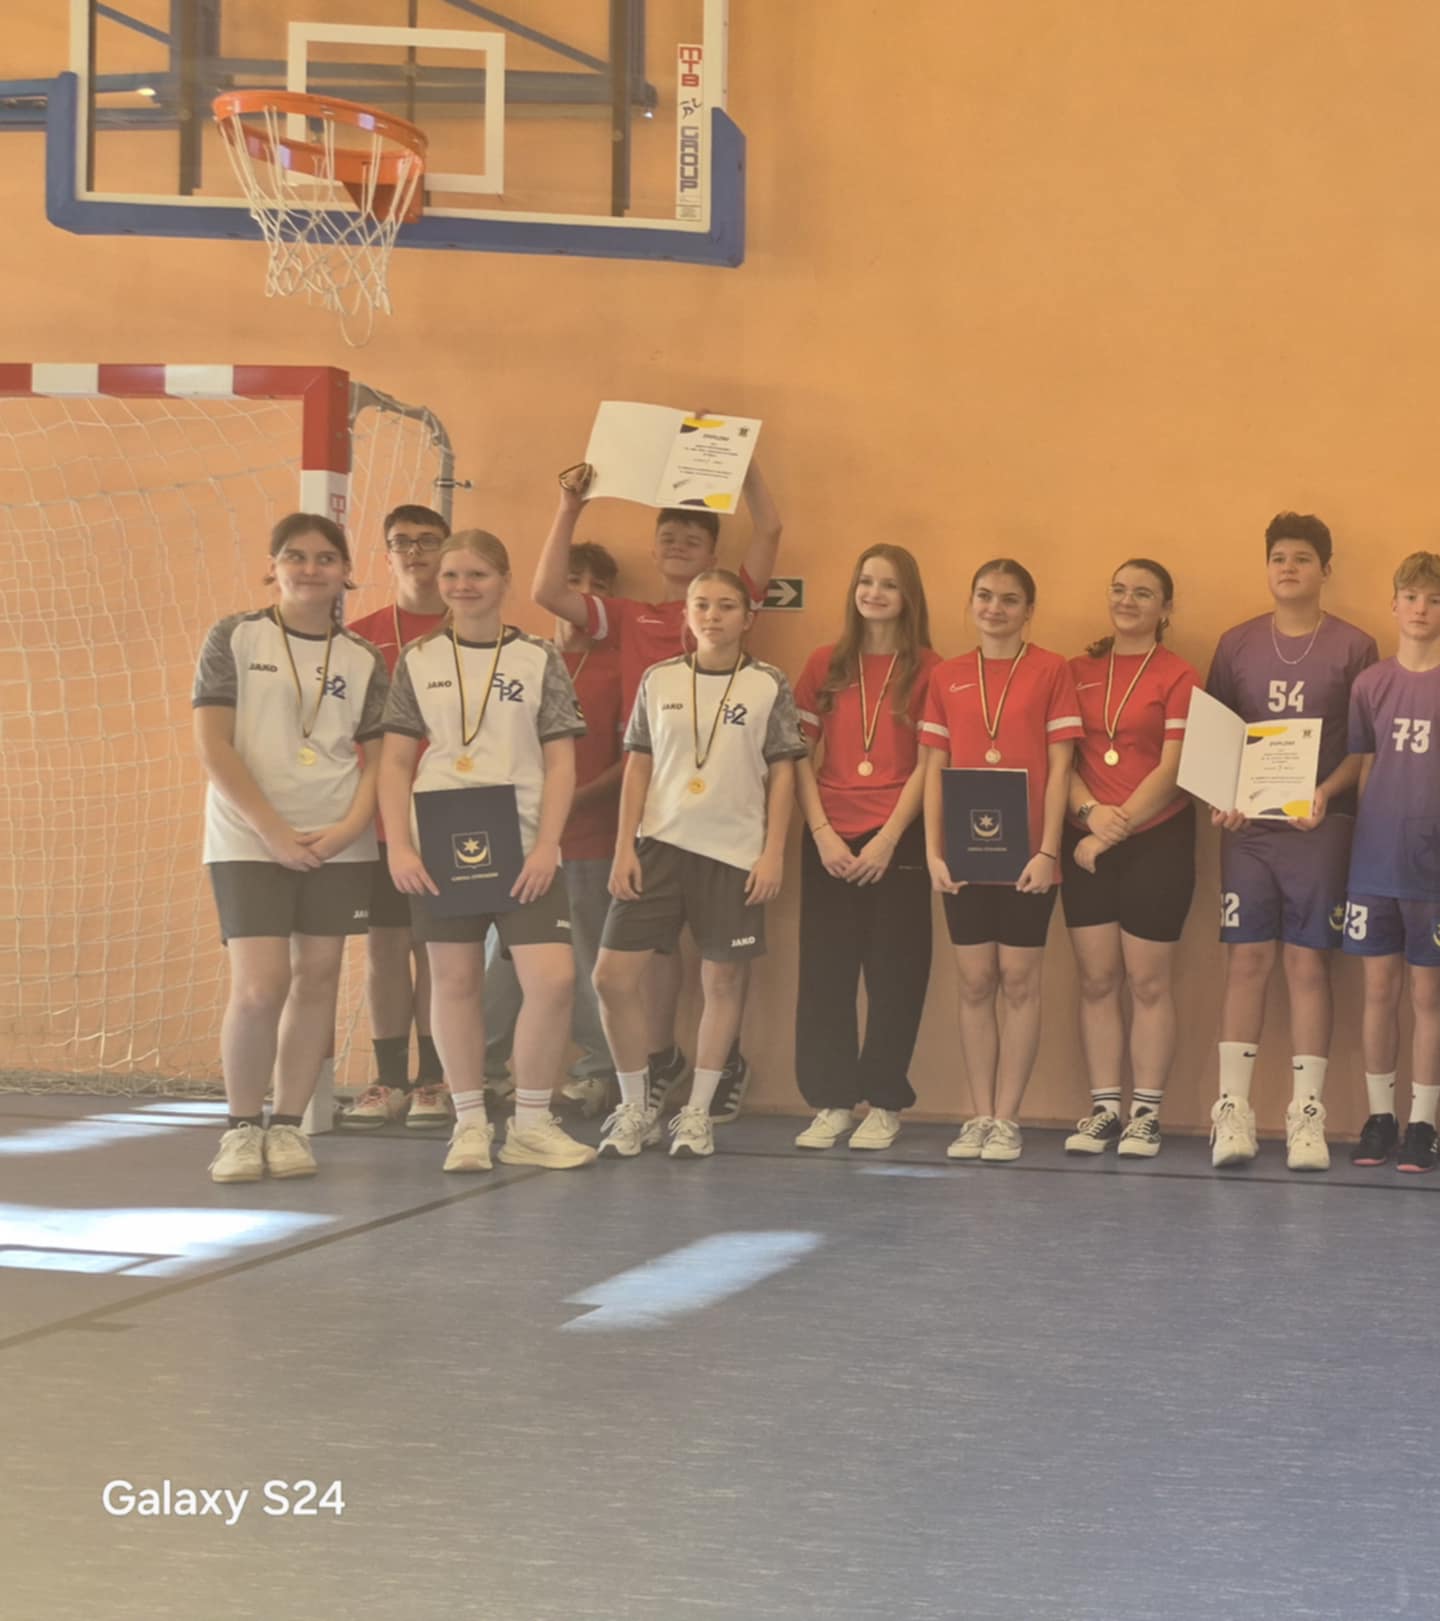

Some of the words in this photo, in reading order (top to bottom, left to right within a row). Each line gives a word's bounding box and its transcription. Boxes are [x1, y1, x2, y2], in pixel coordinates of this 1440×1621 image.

[679, 126, 700, 192] GROUP
[427, 679, 453, 690] JAKO
[1267, 680, 1305, 713] 54
[1392, 717, 1432, 754] 73
[1220, 892, 1241, 928] 2
[1343, 900, 1369, 941] 3
